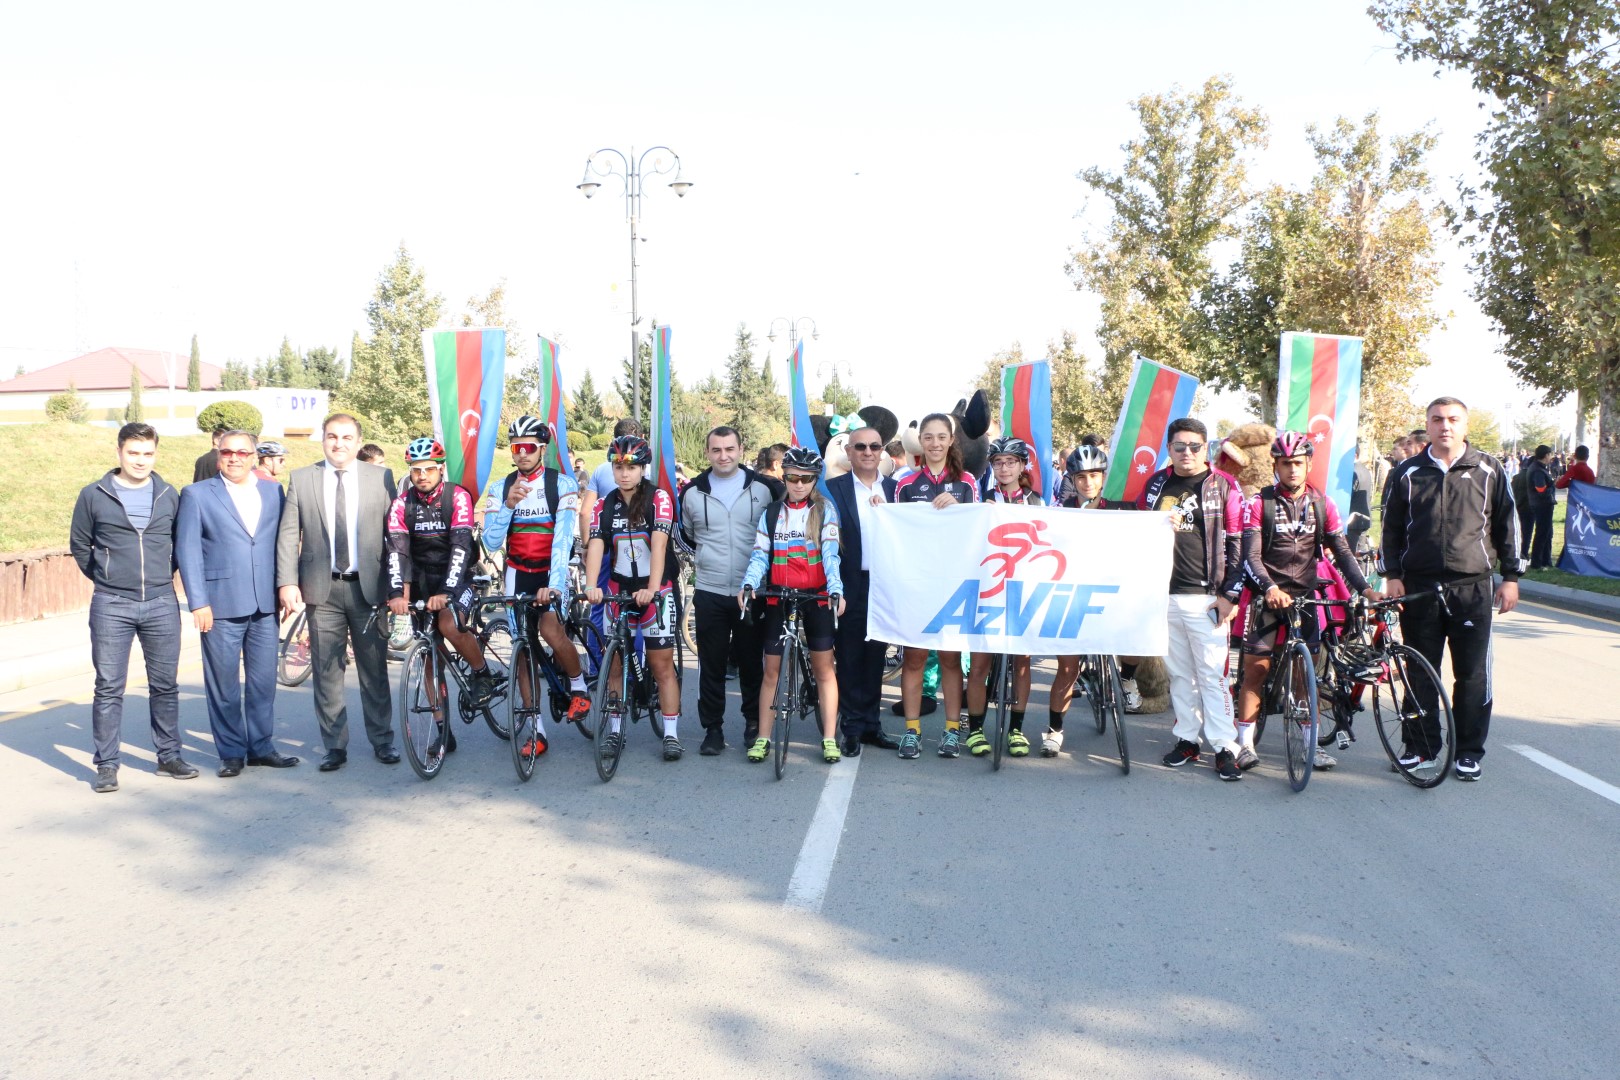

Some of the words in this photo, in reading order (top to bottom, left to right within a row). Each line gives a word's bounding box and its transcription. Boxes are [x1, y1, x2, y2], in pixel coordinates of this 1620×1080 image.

[291, 396, 317, 410] DYP
[414, 520, 447, 531] BAKU
[1275, 520, 1316, 534] BAKU
[1606, 517, 1620, 530] SA
[389, 552, 403, 589] BAKU
[445, 548, 466, 588] BAKU
[459, 587, 473, 607] BAKU
[1218, 677, 1231, 717] AZERBAIJAN
